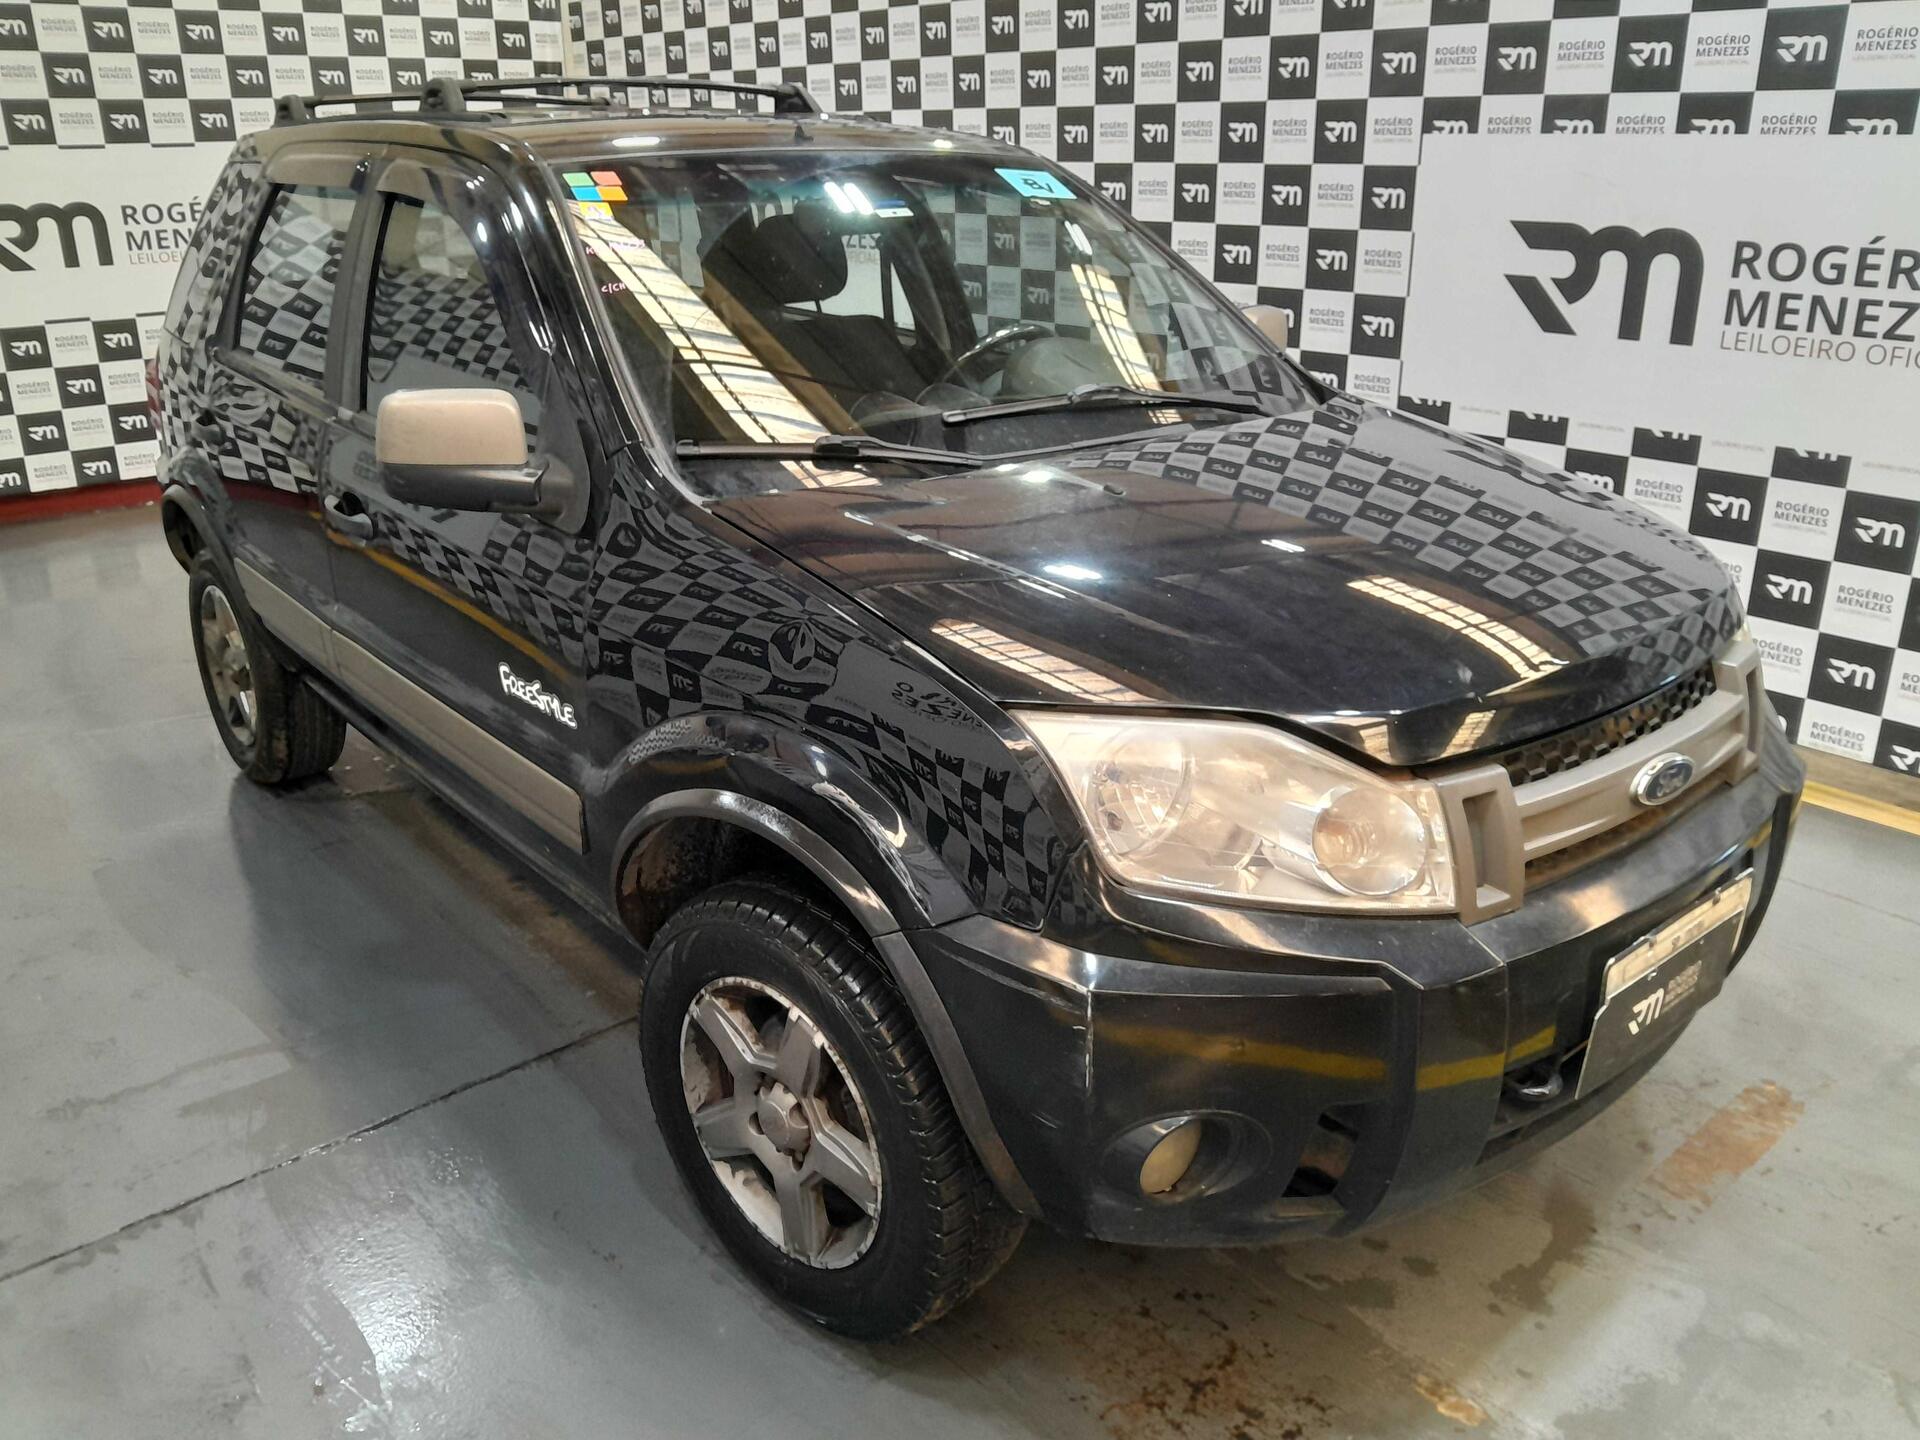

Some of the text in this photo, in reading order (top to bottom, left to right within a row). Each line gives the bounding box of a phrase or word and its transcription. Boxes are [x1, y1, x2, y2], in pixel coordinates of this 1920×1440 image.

[1857, 27, 1918, 39] ROGÉRIO
[1558, 40, 1605, 51] ROGÉRIO
[1698, 35, 1750, 46] ROGÉRIO
[1855, 39, 1917, 51] MENEZES
[1436, 46, 1477, 56] ROGÉRIO
[1558, 51, 1604, 61] MENEZES
[1696, 46, 1749, 57] MENEZES
[1434, 56, 1476, 65] MENEZES
[1488, 116, 1532, 125] ROGÉRIO
[1617, 115, 1665, 125] ROGÉRIO
[1762, 114, 1817, 125] ROGÉRIO
[1720, 330, 1856, 362] LEILOEIRO
[1636, 478, 1683, 493] ROGÉRIO
[1634, 488, 1682, 504] MENEZES
[1776, 501, 1829, 517] ROGÉRIO
[1774, 511, 1827, 528] MENEZES
[1838, 585, 1894, 603] ROGÉRIO
[1836, 595, 1891, 614] MENEZES
[1759, 649, 1801, 667] ENEZES
[1812, 722, 1864, 741] ROGÉRIO
[1809, 731, 1862, 753] MENEZES
